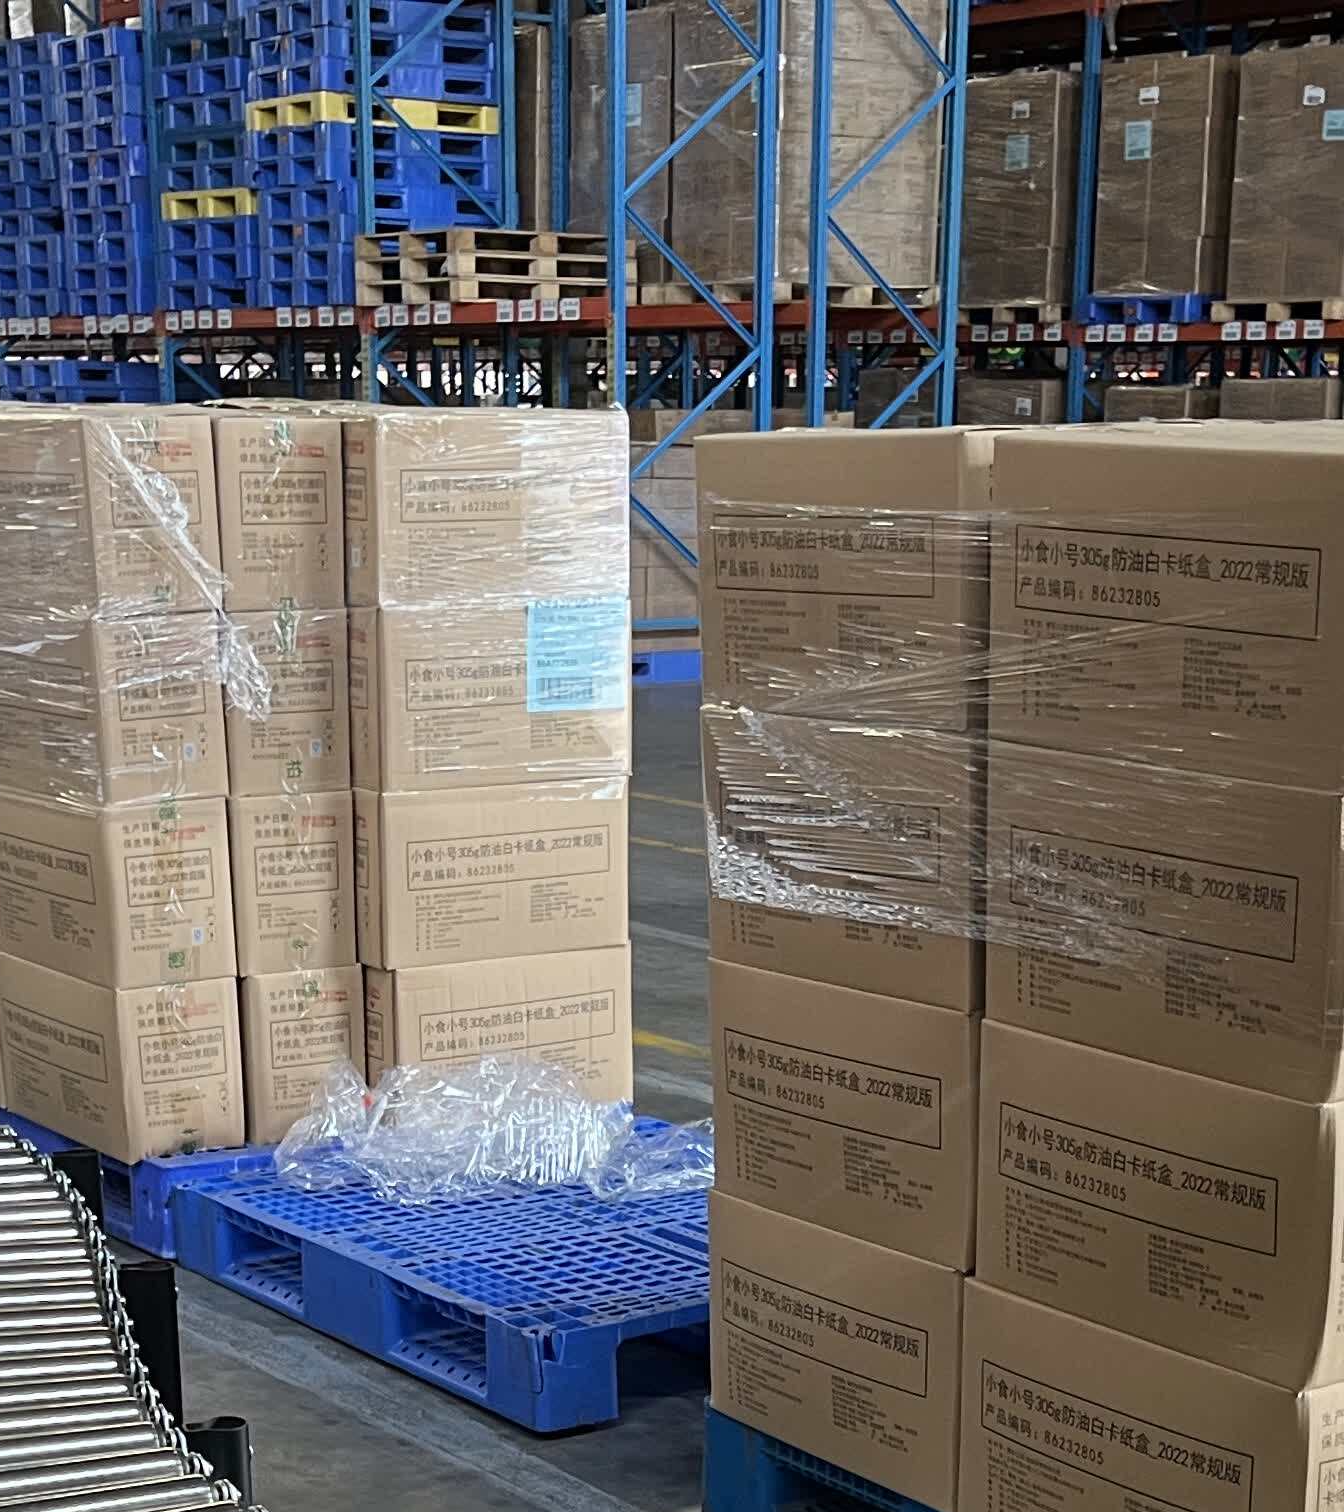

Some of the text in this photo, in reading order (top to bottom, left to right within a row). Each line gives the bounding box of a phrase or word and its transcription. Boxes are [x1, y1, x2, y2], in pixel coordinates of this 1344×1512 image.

[1018, 576, 1161, 608] 产品编码：86232805
[1020, 539, 1310, 590] 小食小号305g防油白卡纸盒_2022常规版
[728, 1040, 934, 1109] 小食小号305g防油白卡纸盒_2022常规版
[728, 1069, 825, 1110] 产品编码：86232805
[1002, 1147, 1128, 1203] 产品编码：86232805
[1004, 1115, 1267, 1212] 小食小号305g防油白卡纸盒_2022常规版
[724, 1272, 921, 1359] 小食小号305g防油白卡纸盒_2022常规版
[724, 1298, 816, 1350] 产品编码：86232805
[984, 1402, 1106, 1467] 产品编码：86232805
[985, 1374, 1243, 1487] 小食小号305g防油白卡纸盒_2022常规版
